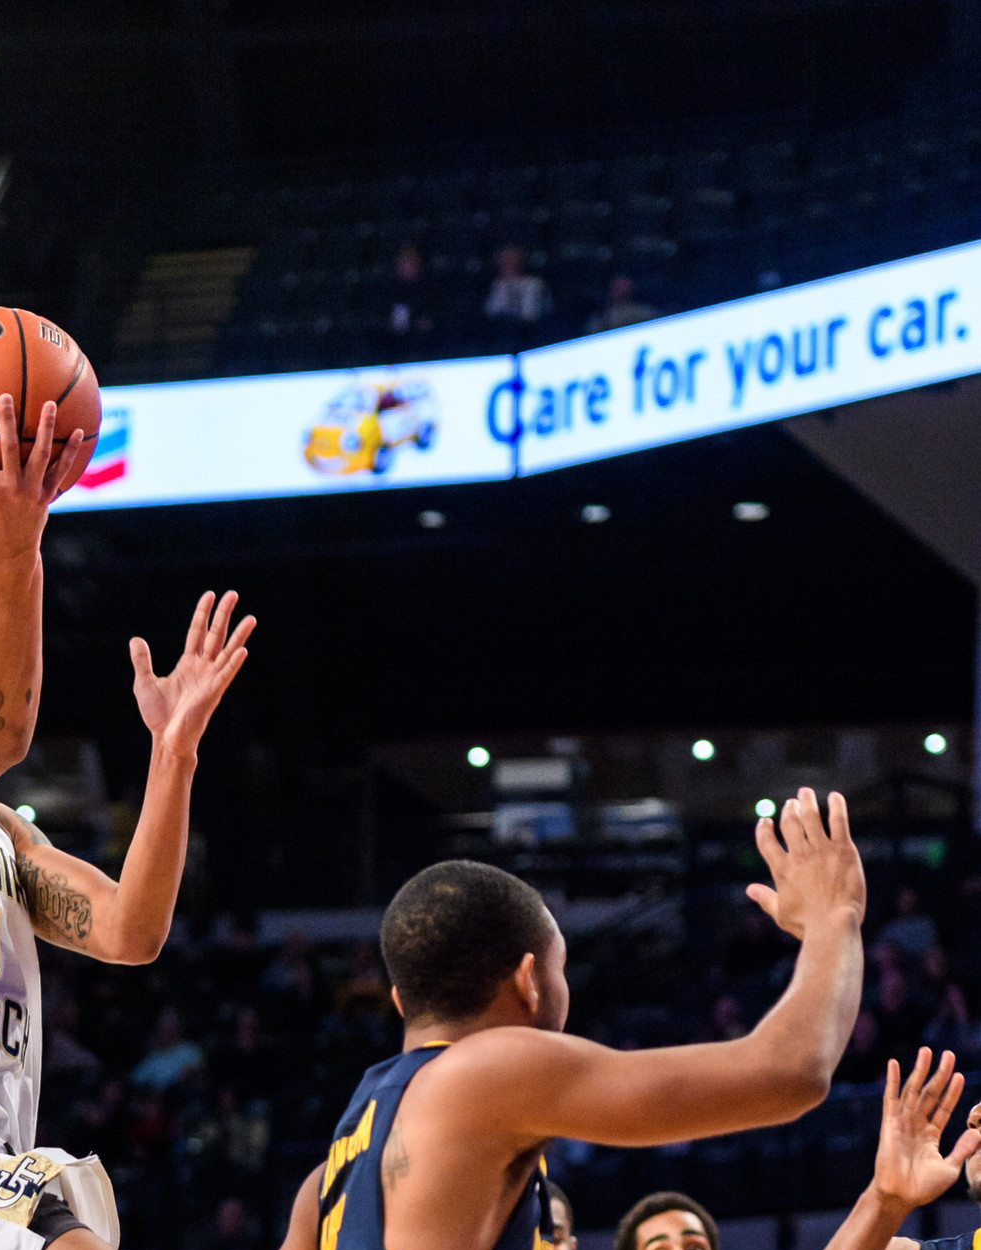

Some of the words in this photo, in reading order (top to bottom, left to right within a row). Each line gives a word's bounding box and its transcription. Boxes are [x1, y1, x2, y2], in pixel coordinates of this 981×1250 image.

[485, 373, 610, 444] Care
[632, 344, 706, 414] for
[725, 316, 848, 409] your
[868, 288, 969, 357] car.
